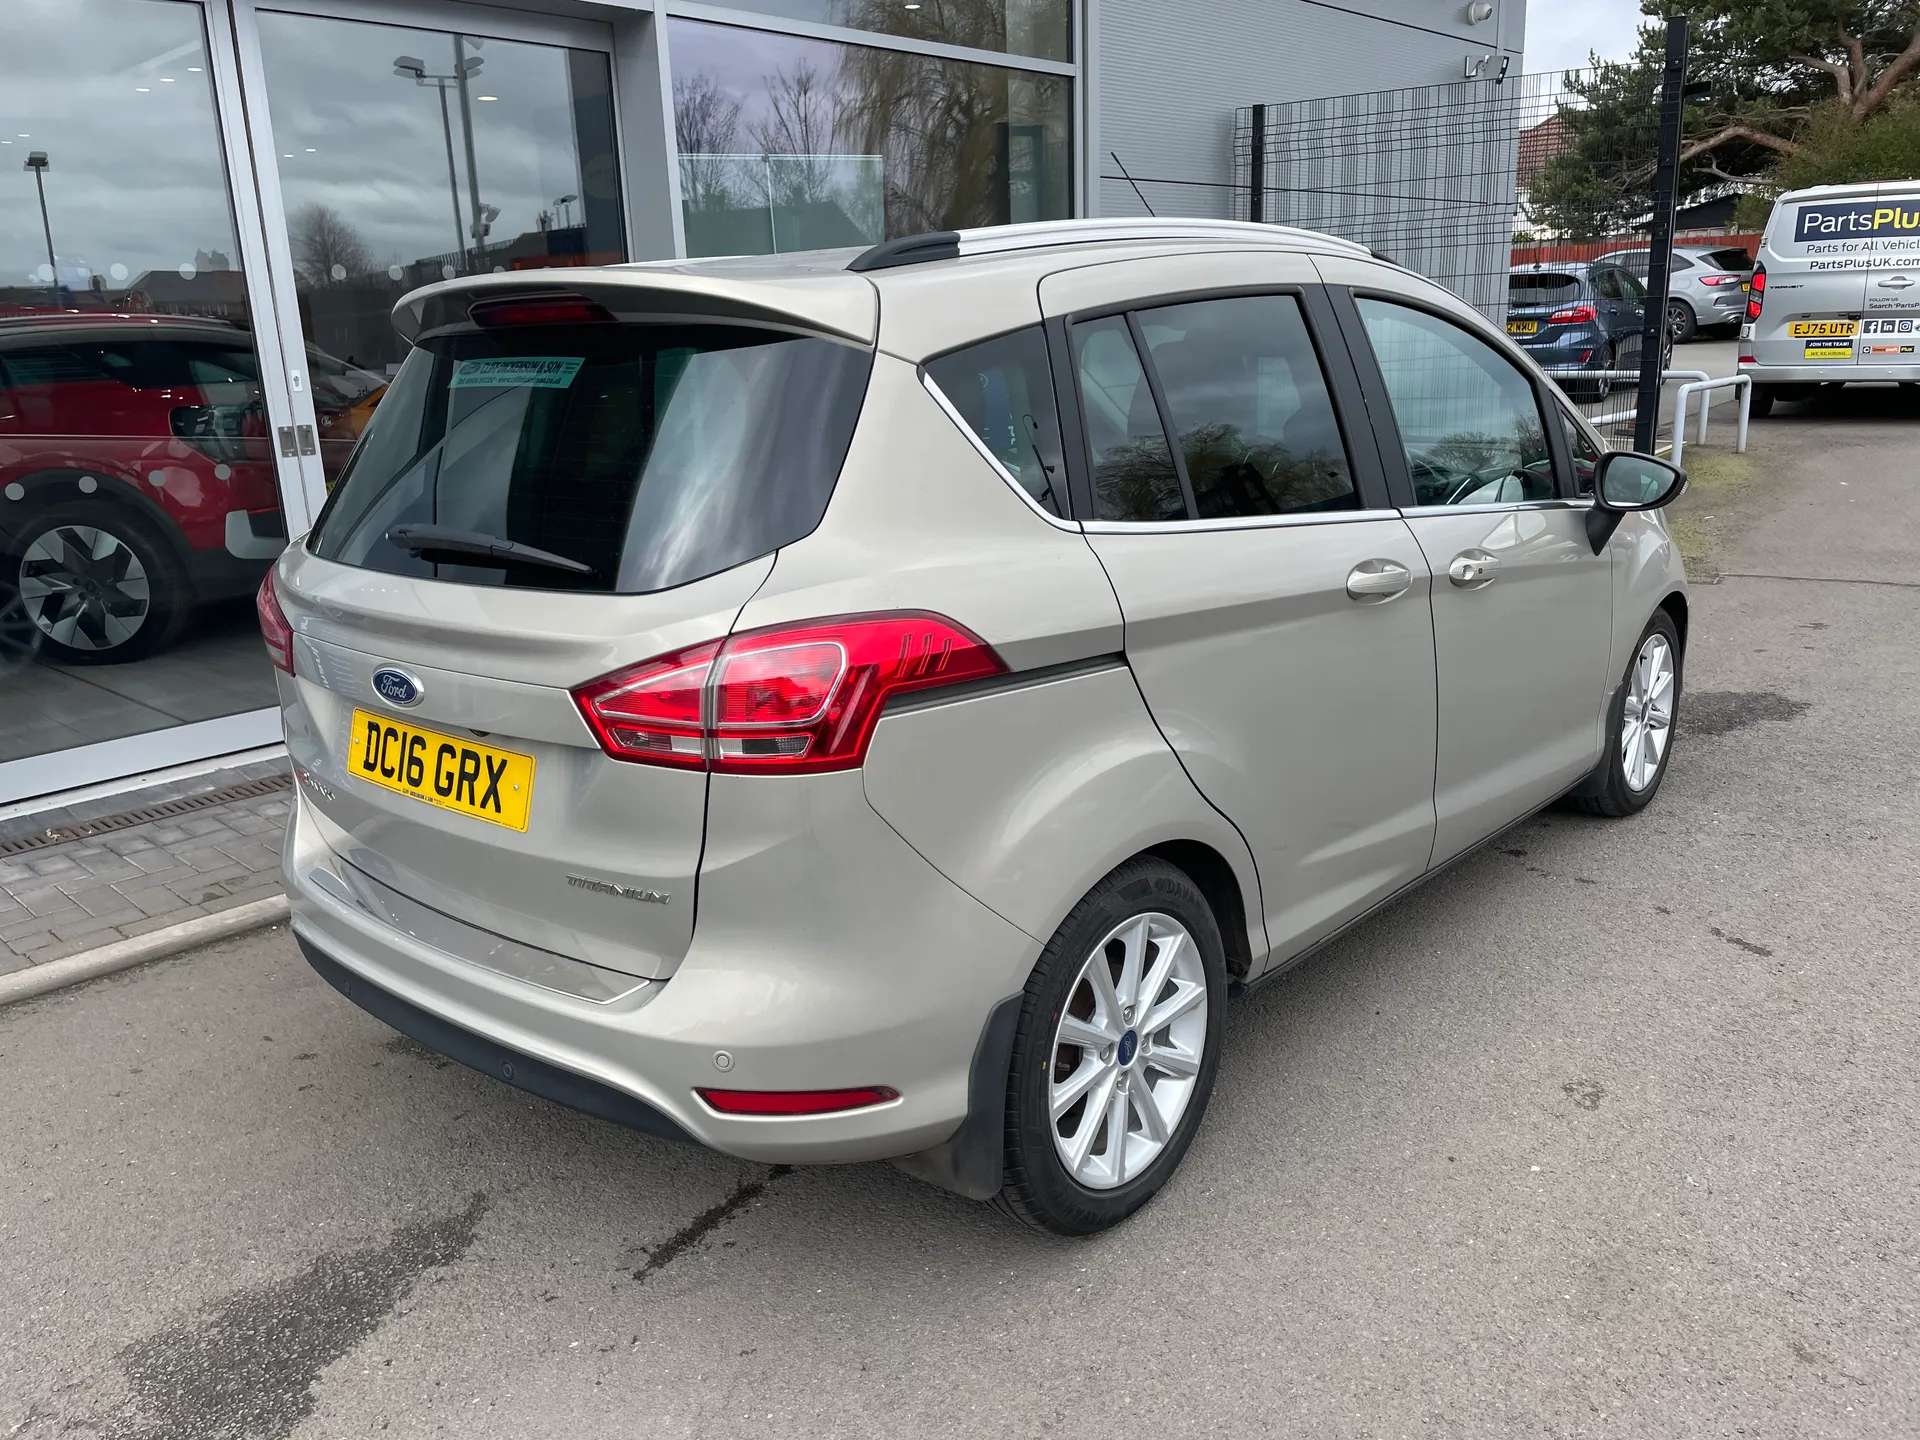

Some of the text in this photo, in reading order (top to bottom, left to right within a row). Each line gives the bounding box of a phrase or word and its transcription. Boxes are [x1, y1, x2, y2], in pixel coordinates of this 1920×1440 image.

[1803, 207, 1920, 234] PartsPlu
[1806, 244, 1839, 254] Parts
[1842, 242, 1859, 252] for
[1861, 241, 1878, 251] All
[1794, 323, 1855, 334] EJ75 UTR
[381, 675, 407, 699] Ford
[363, 720, 427, 788] DC16
[433, 743, 508, 814] GRX
[566, 872, 671, 905] TITANIUM
